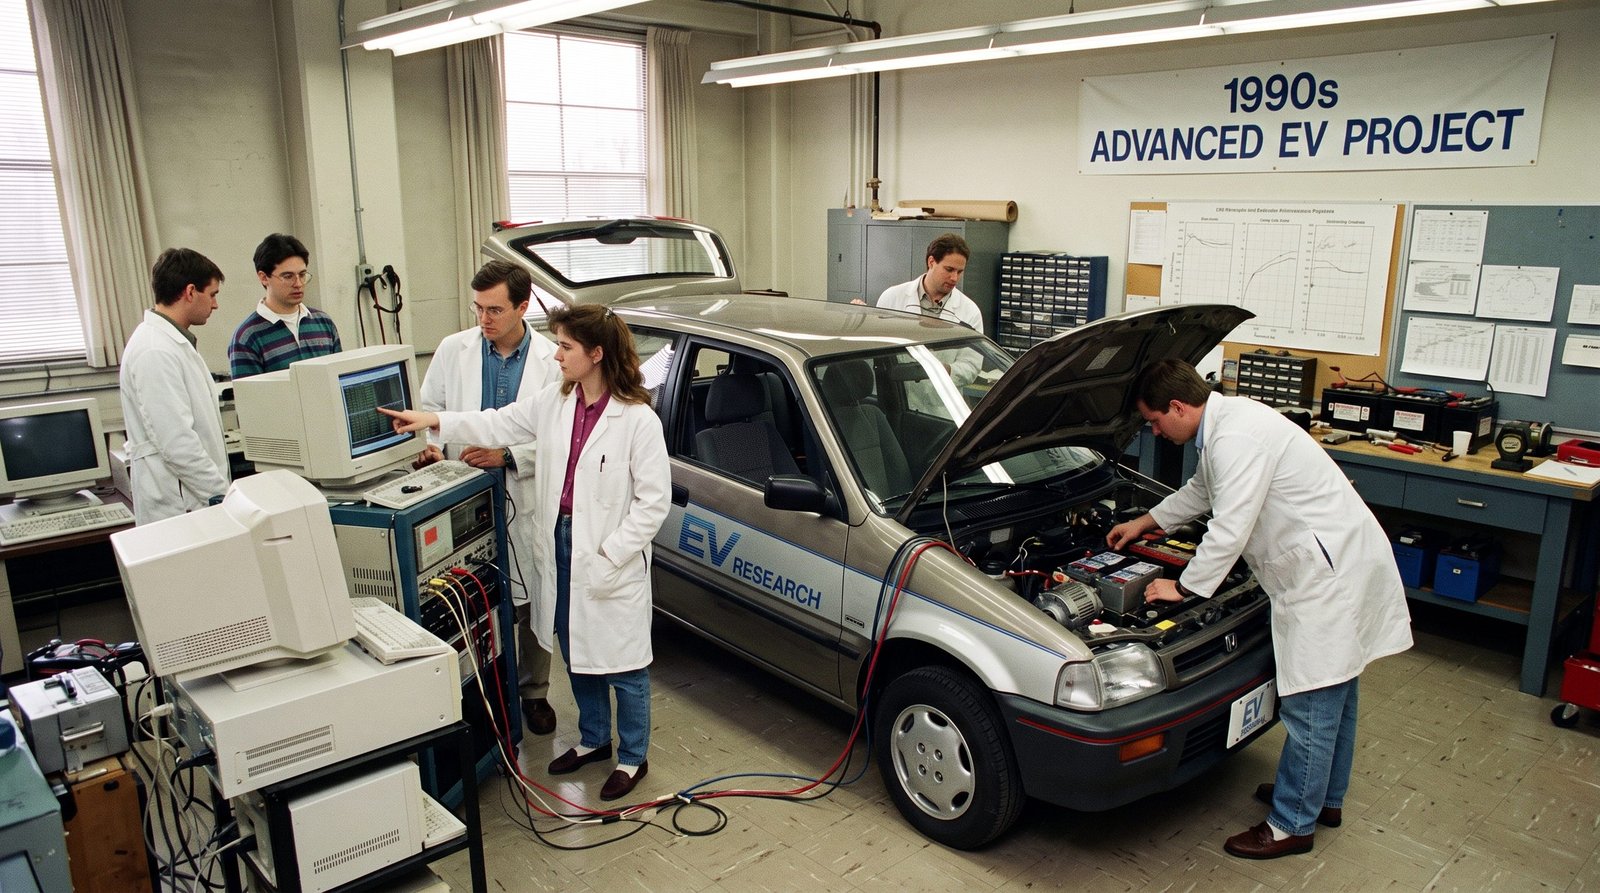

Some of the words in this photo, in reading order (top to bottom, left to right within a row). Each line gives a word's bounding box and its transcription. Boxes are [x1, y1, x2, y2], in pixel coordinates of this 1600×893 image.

[1223, 72, 1339, 113] 1990s
[1091, 124, 1264, 162] ADVANCED
[1279, 121, 1329, 158] EV
[1343, 108, 1525, 156] PROJECT
[678, 512, 742, 567] EV
[732, 557, 822, 610] RESEARCH
[1242, 691, 1264, 728] EV
